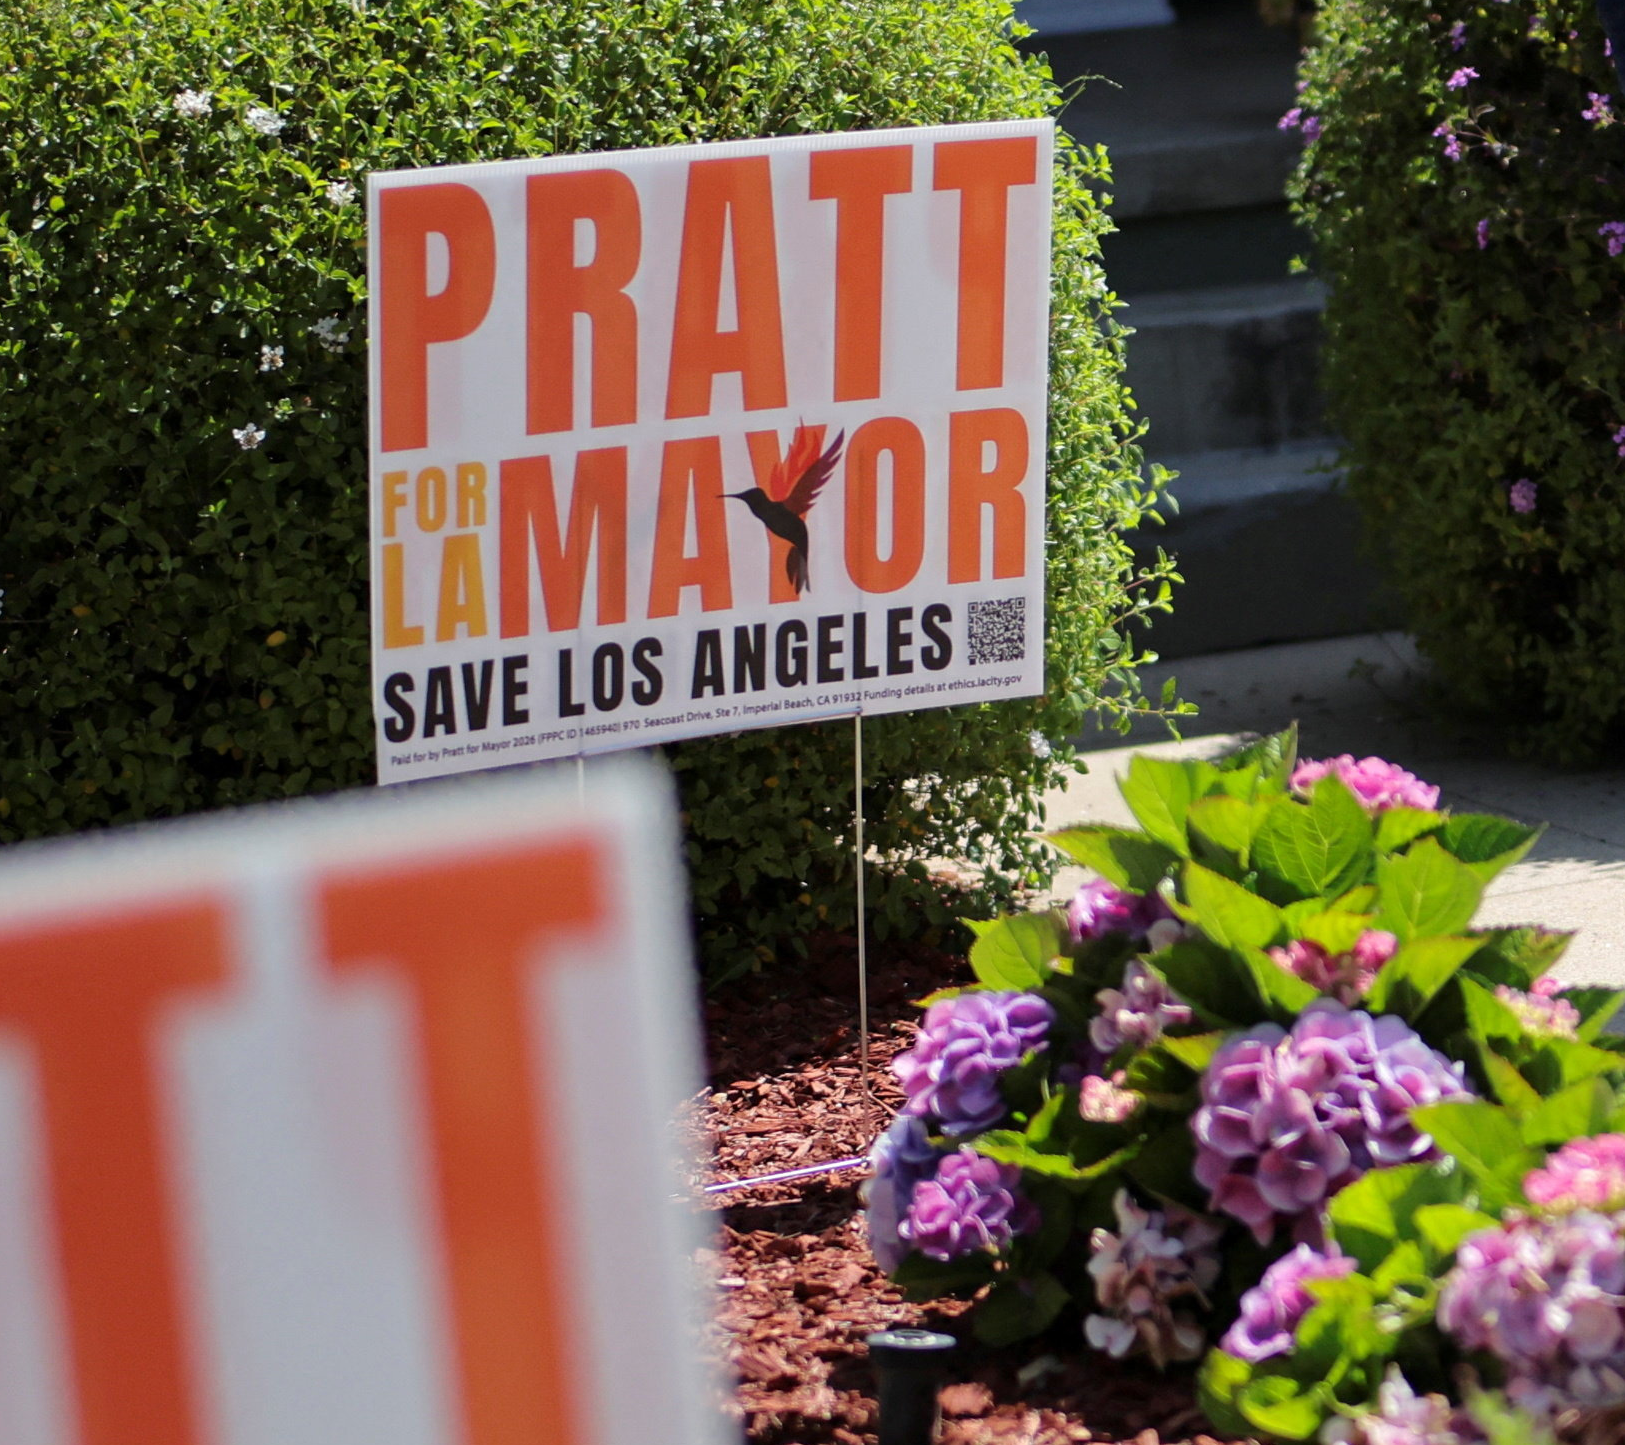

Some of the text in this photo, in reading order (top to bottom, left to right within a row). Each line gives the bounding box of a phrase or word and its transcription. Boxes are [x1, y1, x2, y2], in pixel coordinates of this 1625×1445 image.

[379, 137, 1038, 452] PRATT
[382, 461, 488, 538] FOR
[499, 407, 1030, 640] MAYOR
[382, 533, 489, 650] LA
[383, 603, 954, 745] SAVE LOS ANGELES
[391, 753, 411, 766] Paid
[413, 752, 425, 763] for
[429, 750, 440, 761] by
[442, 746, 465, 758] Pratt
[466, 744, 480, 754] for
[481, 740, 511, 753] Mayor
[513, 735, 536, 747] 2026
[538, 731, 565, 746] (FPPC
[567, 728, 577, 739] ID
[623, 720, 640, 732] 970
[644, 712, 685, 728] Seacoast
[687, 709, 713, 724] Drive,
[716, 706, 730, 719] Ste
[732, 706, 741, 717] 7,
[743, 700, 782, 715] Imperial
[784, 697, 814, 709] Beach,
[817, 694, 831, 706] CA
[832, 691, 862, 704] 91932
[864, 687, 902, 700] Funding
[904, 683, 935, 696] details
[937, 681, 946, 691] at
[948, 674, 1023, 691] ethics.lacity.gov
